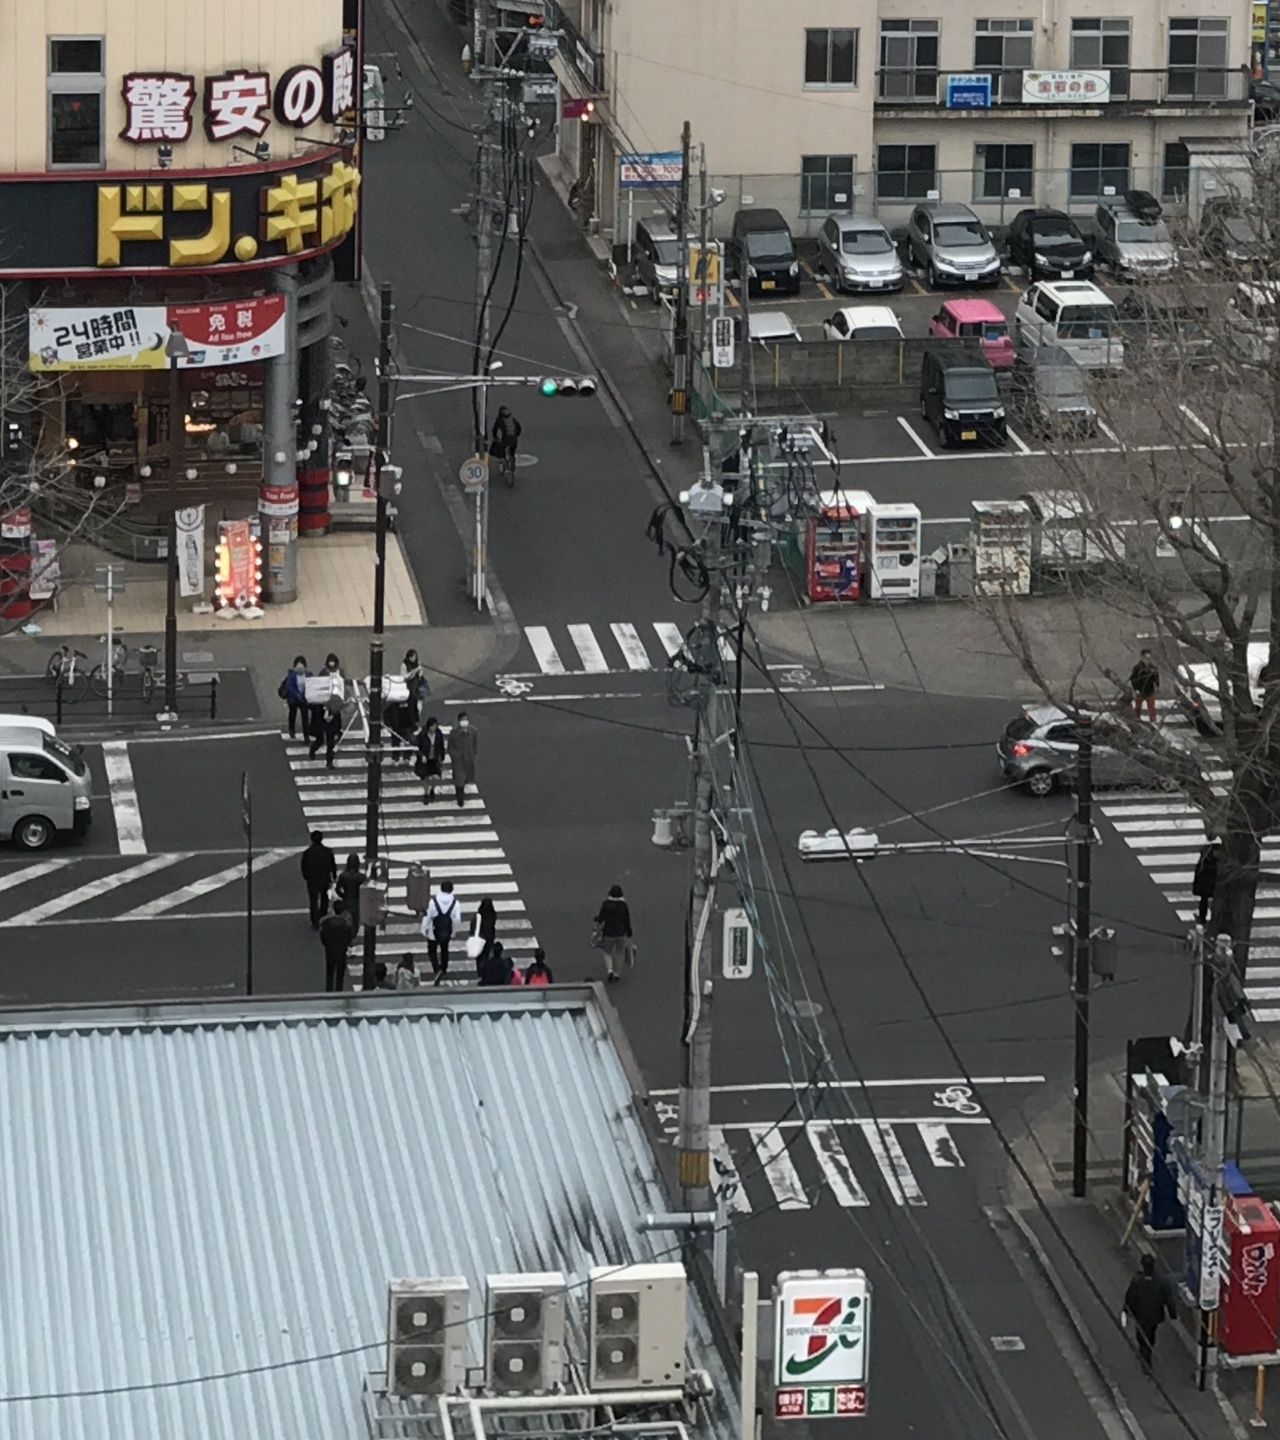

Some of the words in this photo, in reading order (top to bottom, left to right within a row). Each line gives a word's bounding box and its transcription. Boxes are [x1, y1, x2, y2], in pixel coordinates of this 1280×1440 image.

[53, 309, 137, 347] 24時間
[208, 310, 253, 332] 免税
[467, 466, 482, 480] 30
